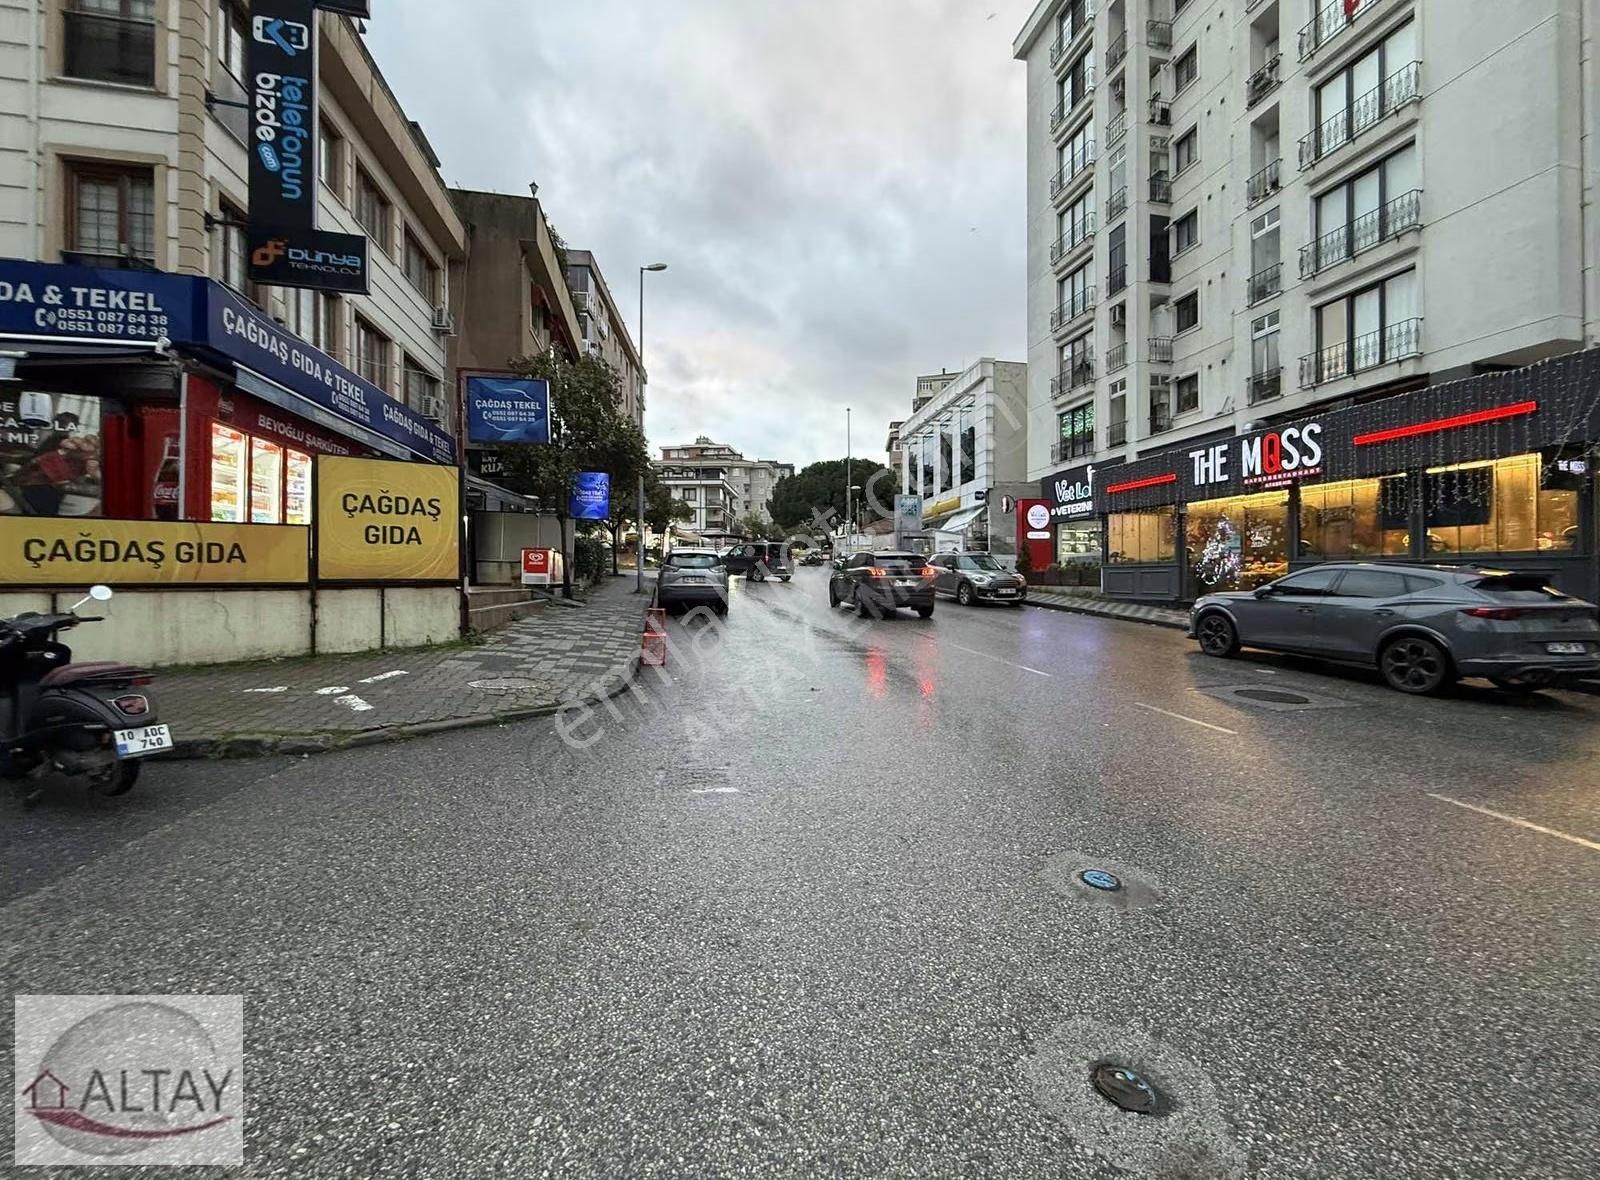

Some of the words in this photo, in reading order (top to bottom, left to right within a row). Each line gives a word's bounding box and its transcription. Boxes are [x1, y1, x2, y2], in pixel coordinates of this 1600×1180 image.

[256, 72, 281, 142] bizde
[281, 75, 308, 200] telefonun
[42, 285, 64, 305] &
[71, 286, 163, 312] TEKEL
[58, 308, 94, 321] 0551
[98, 311, 123, 322] 087
[128, 313, 146, 324] 64
[150, 315, 168, 326] 38
[58, 320, 94, 333] 0551
[98, 323, 123, 334] 087
[128, 325, 146, 336] 64
[150, 327, 168, 337] 39
[223, 307, 289, 365] ÇAĞDAŞ
[291, 349, 322, 381] GIDA
[324, 368, 333, 387] &
[334, 373, 367, 406] TEKEL
[475, 399, 512, 410] ÇAĞDAŞ
[514, 401, 541, 410] TEKEL
[258, 414, 304, 442] BEYOĞLU
[383, 403, 414, 435] ÇAĞDAŞ
[1189, 444, 1229, 486] THE
[1055, 480, 1075, 503] Vet
[342, 489, 441, 522] ÇAĞDAŞ
[364, 525, 422, 545] GIDA
[24, 532, 165, 569] ÇAĞDAŞ
[175, 542, 247, 564] GIDA
[120, 731, 134, 741] 10
[141, 737, 163, 748] 740
